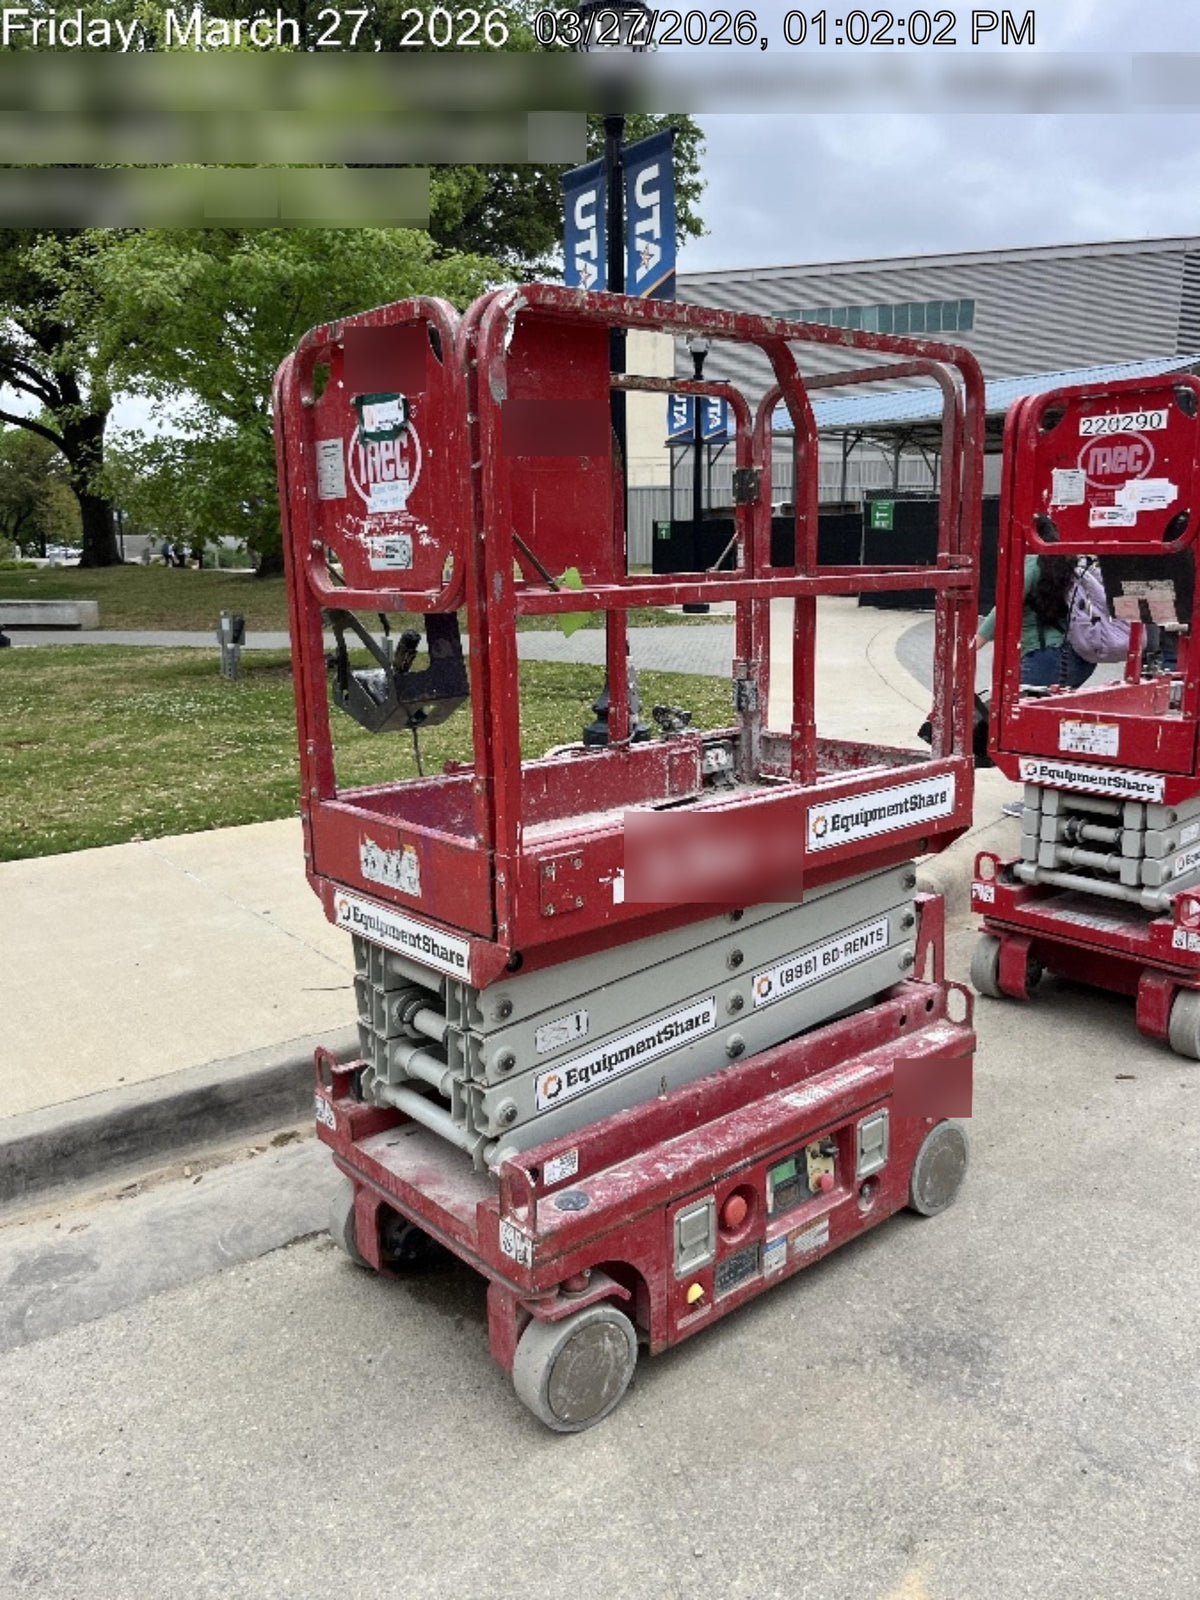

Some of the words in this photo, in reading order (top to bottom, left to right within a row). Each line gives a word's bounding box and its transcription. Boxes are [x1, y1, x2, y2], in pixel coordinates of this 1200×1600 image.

[574, 190, 598, 289] UTA
[635, 163, 661, 284] UTA
[1082, 412, 1162, 434] 220290
[1040, 765, 1155, 793] EquipmentShare
[830, 790, 947, 832] EquipmentShare
[351, 904, 465, 967] EquipmentShare
[565, 1010, 710, 1088] EquipmentShare
